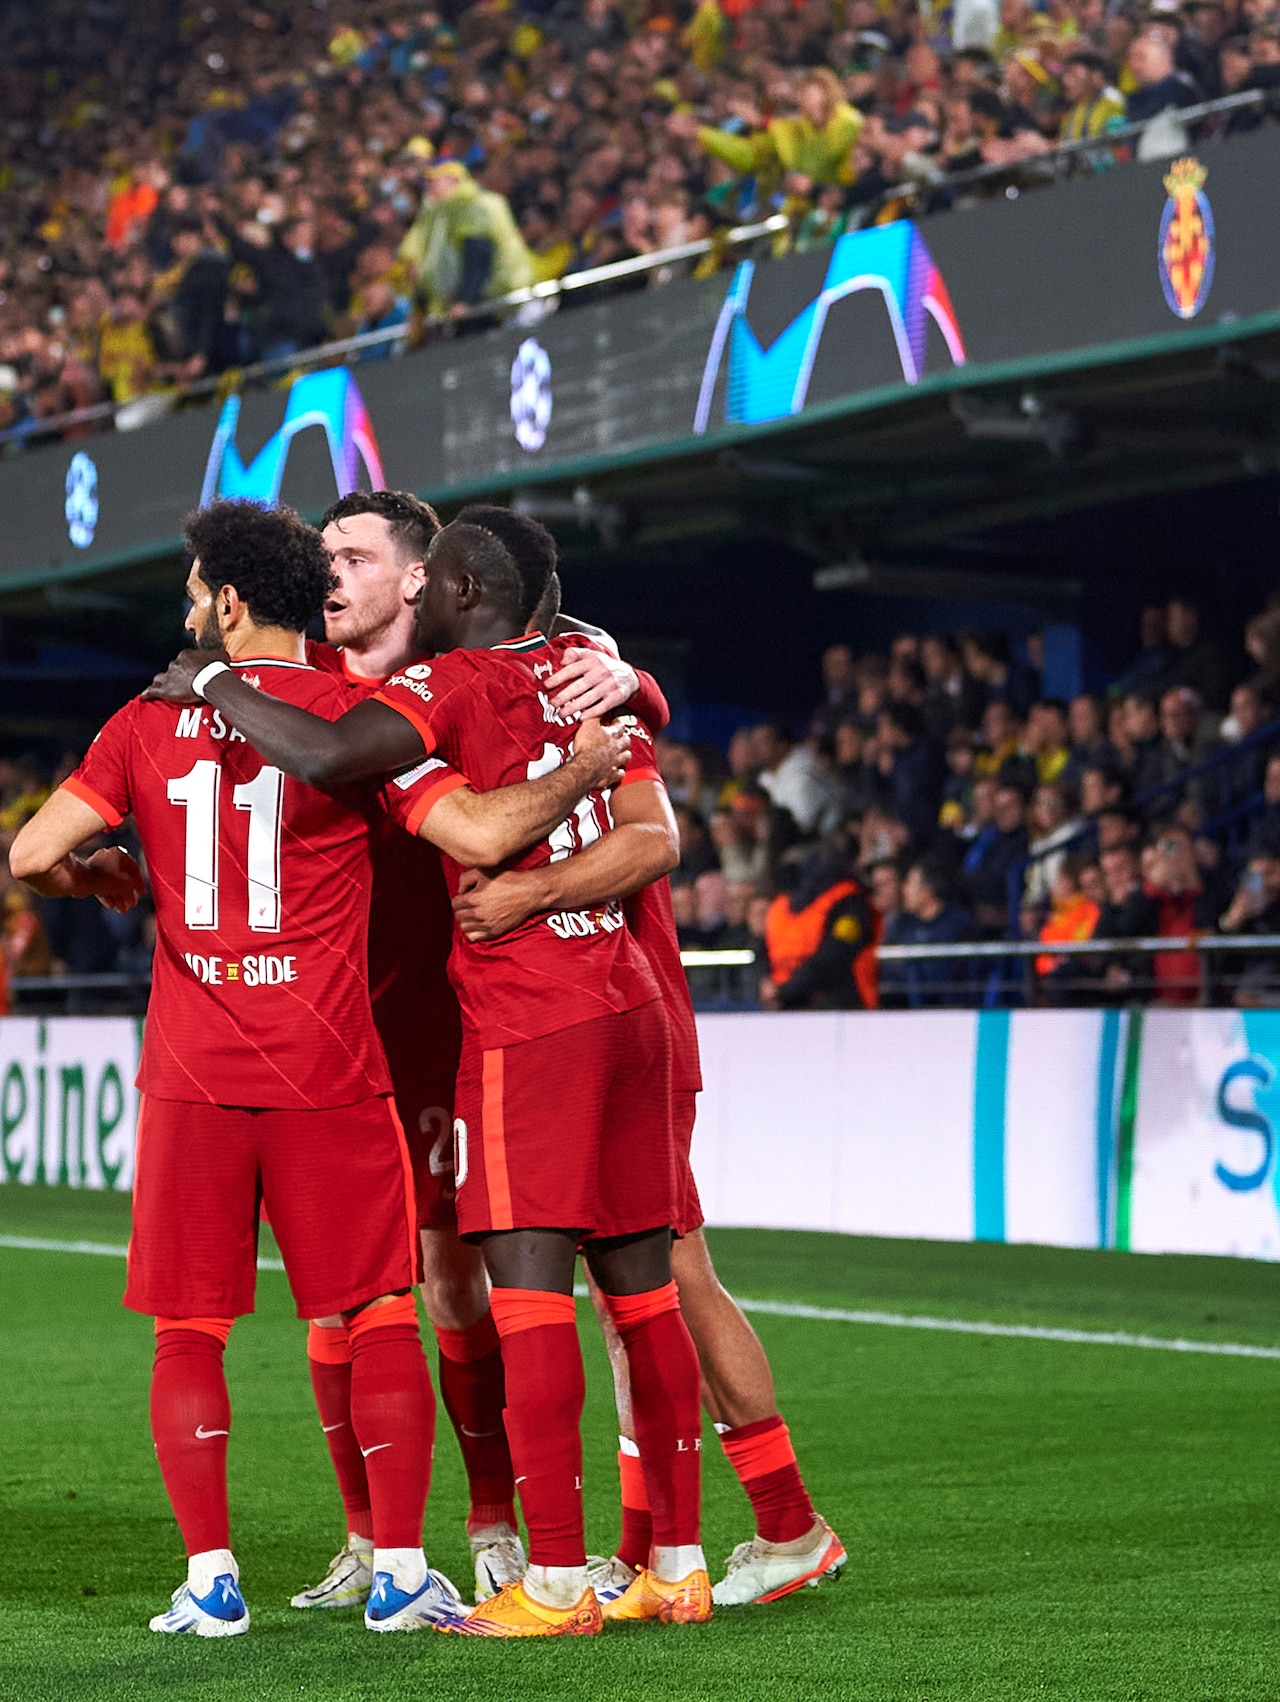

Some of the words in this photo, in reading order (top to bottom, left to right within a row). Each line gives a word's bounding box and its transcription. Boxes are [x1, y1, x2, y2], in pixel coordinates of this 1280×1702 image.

[385, 675, 434, 703] xpedia
[167, 760, 285, 933] 11
[546, 911, 599, 939] SIDE
[181, 952, 224, 985] IDE
[242, 954, 299, 987] SIDE
[419, 1106, 453, 1177] 2
